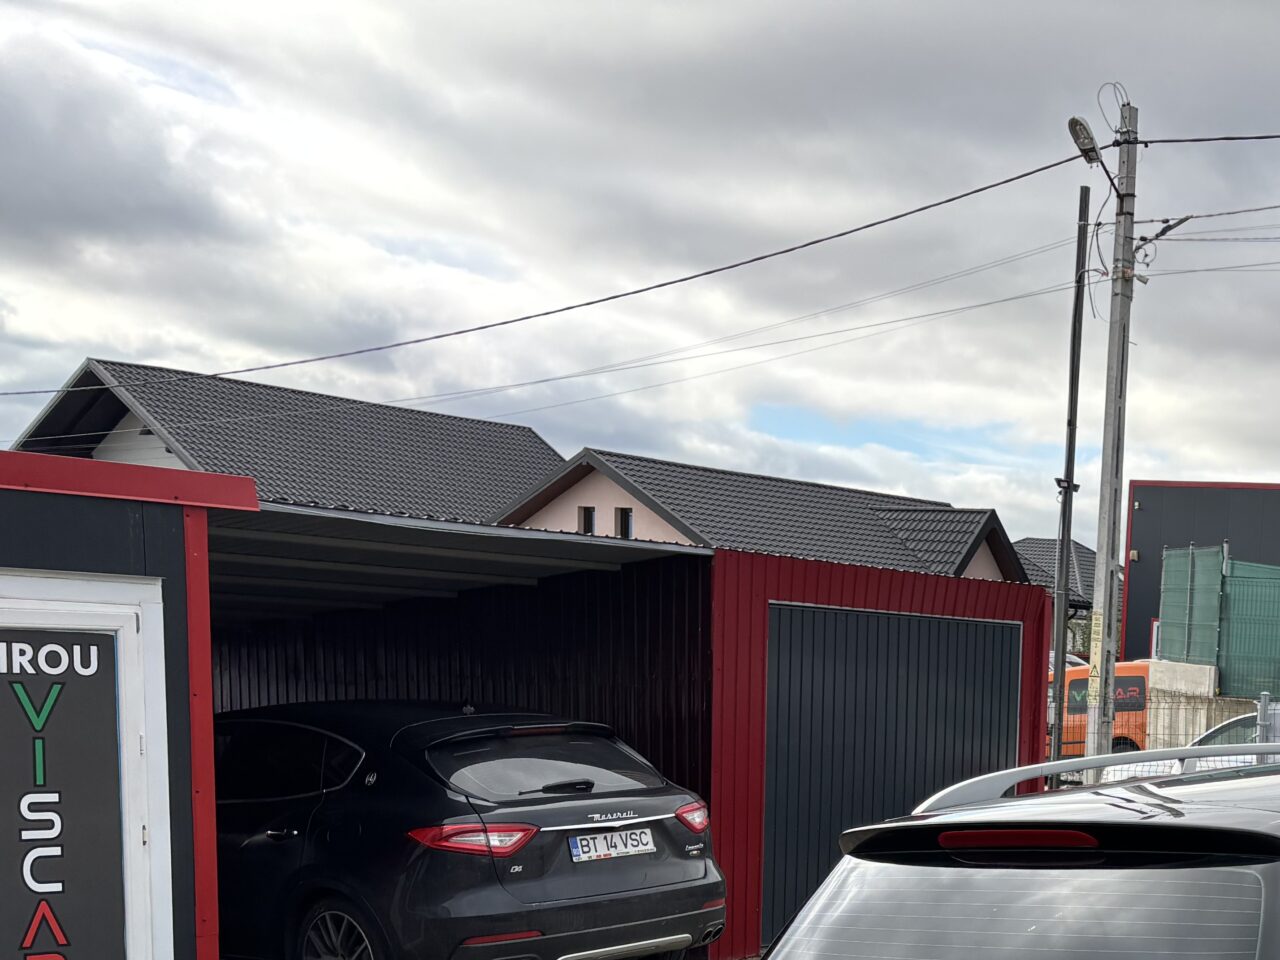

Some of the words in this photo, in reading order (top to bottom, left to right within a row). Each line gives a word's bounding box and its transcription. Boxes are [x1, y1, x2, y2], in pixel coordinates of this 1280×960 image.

[580, 836, 598, 854] BT
[604, 834, 618, 851] 14
[619, 831, 650, 849] VSC
